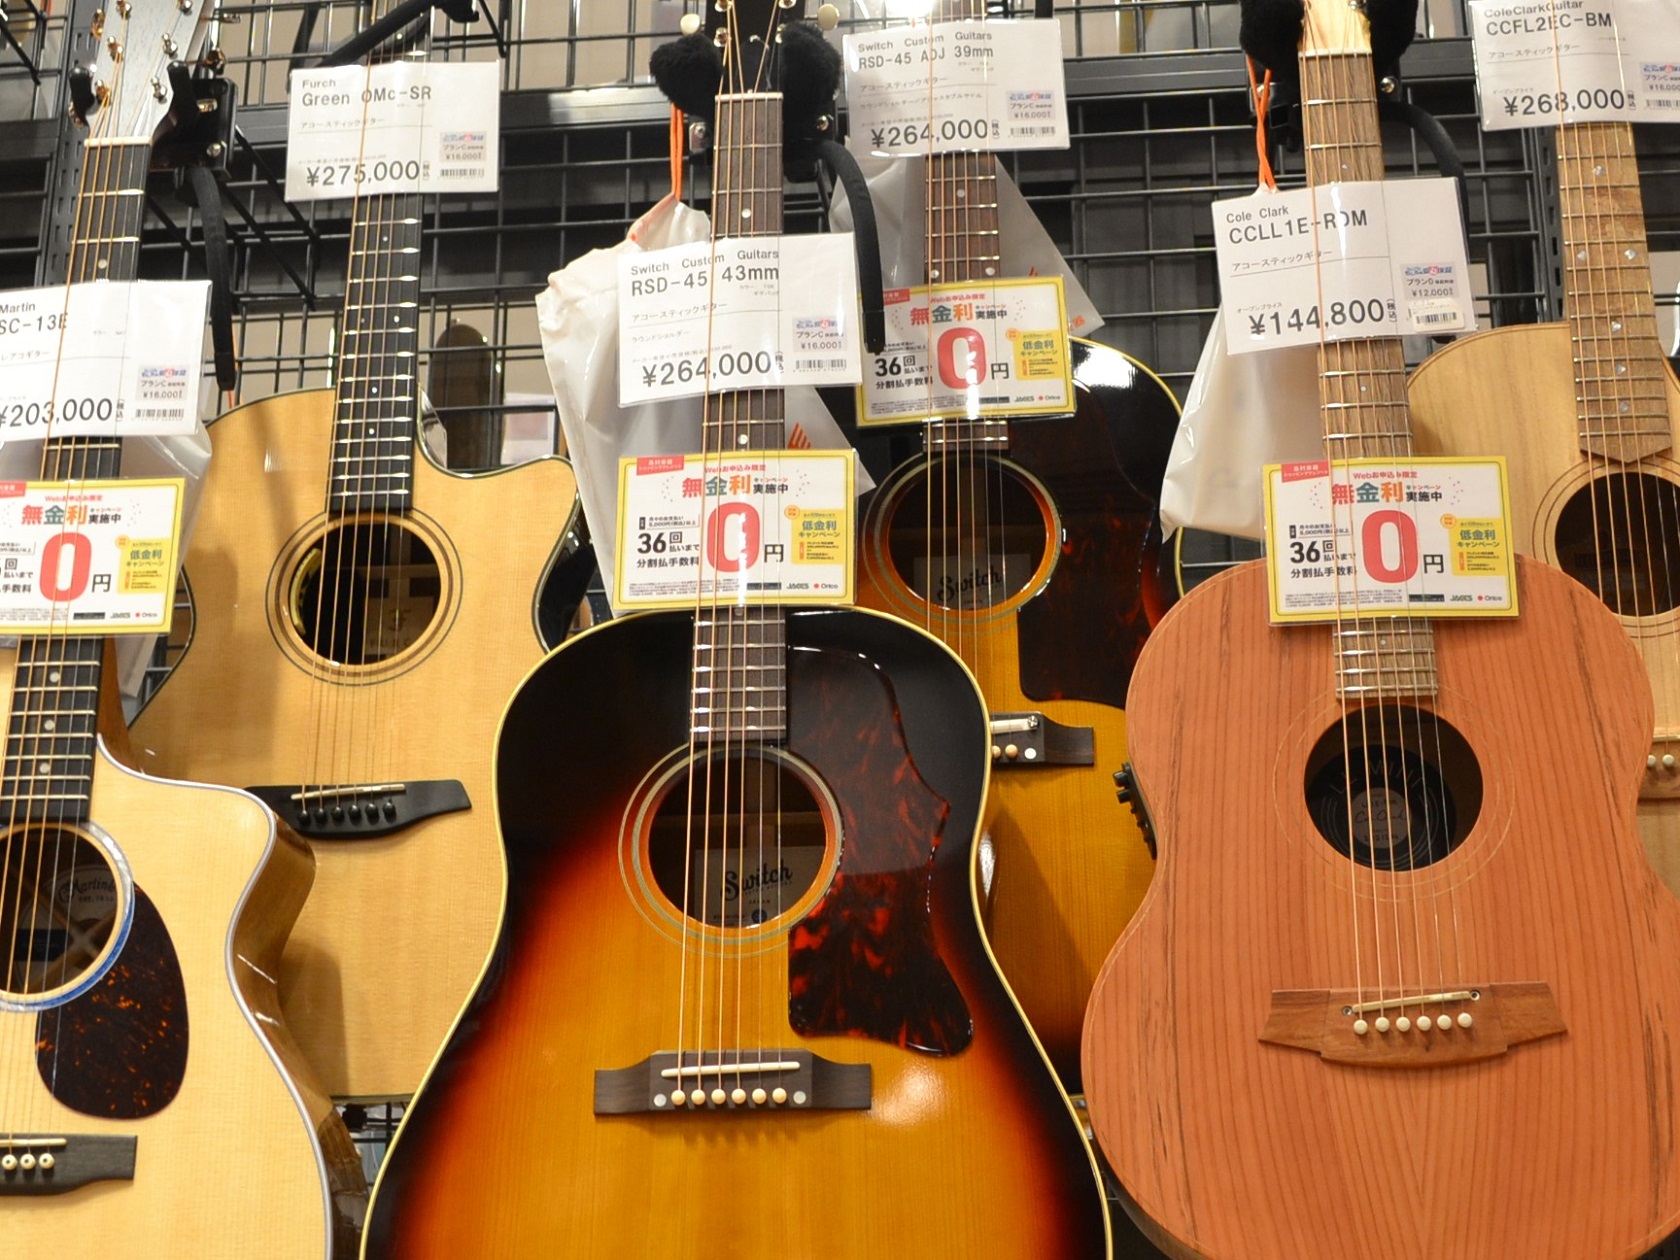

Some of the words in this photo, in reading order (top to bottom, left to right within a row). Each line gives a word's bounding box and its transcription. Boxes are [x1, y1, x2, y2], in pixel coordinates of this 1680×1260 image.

[1486, 12, 1612, 36] CCFL2EC-BM
[858, 41, 893, 52] Switch
[904, 34, 944, 47] Custom
[955, 32, 992, 41] Guitars
[859, 52, 912, 70] RSD-45
[954, 45, 994, 58] 39mm
[302, 79, 336, 90] Furch
[302, 92, 350, 107] Green
[361, 85, 432, 104] OMc-SR
[1503, 89, 1625, 117] ¥268,000
[871, 119, 987, 148] ¥264,000
[306, 160, 420, 187] ¥275,000
[1226, 212, 1252, 224] Cole
[1259, 205, 1289, 219] Clark
[631, 263, 669, 276] Switch
[682, 253, 725, 268] Custom
[737, 249, 779, 260] Guitars
[631, 271, 708, 297] RSD-45
[721, 265, 779, 283] 43mm
[0, 303, 36, 314] Martin
[910, 303, 973, 325] 無金利
[976, 310, 1007, 319] 実施中
[1250, 299, 1384, 336] ¥144,800
[0, 313, 68, 335] SC-13E
[642, 351, 772, 387] ¥264,000
[875, 356, 901, 377] 36
[937, 327, 987, 389] 0
[991, 363, 1009, 380] 円
[0, 398, 113, 428] ¥203,000
[682, 475, 751, 498] 無金利
[753, 484, 788, 494] 実施中
[1332, 481, 1404, 504] 無金利
[1406, 491, 1442, 502] 実施中
[22, 505, 88, 525] 無金利
[89, 514, 121, 523] 実施中
[637, 532, 666, 554] 36
[706, 501, 760, 573] 0
[764, 544, 784, 563] 円
[1361, 509, 1418, 584] 0
[1423, 554, 1444, 574] 円
[1290, 540, 1320, 564] 36
[39, 532, 92, 602] 0
[92, 574, 111, 593] 円
[720, 859, 793, 901] Switch
